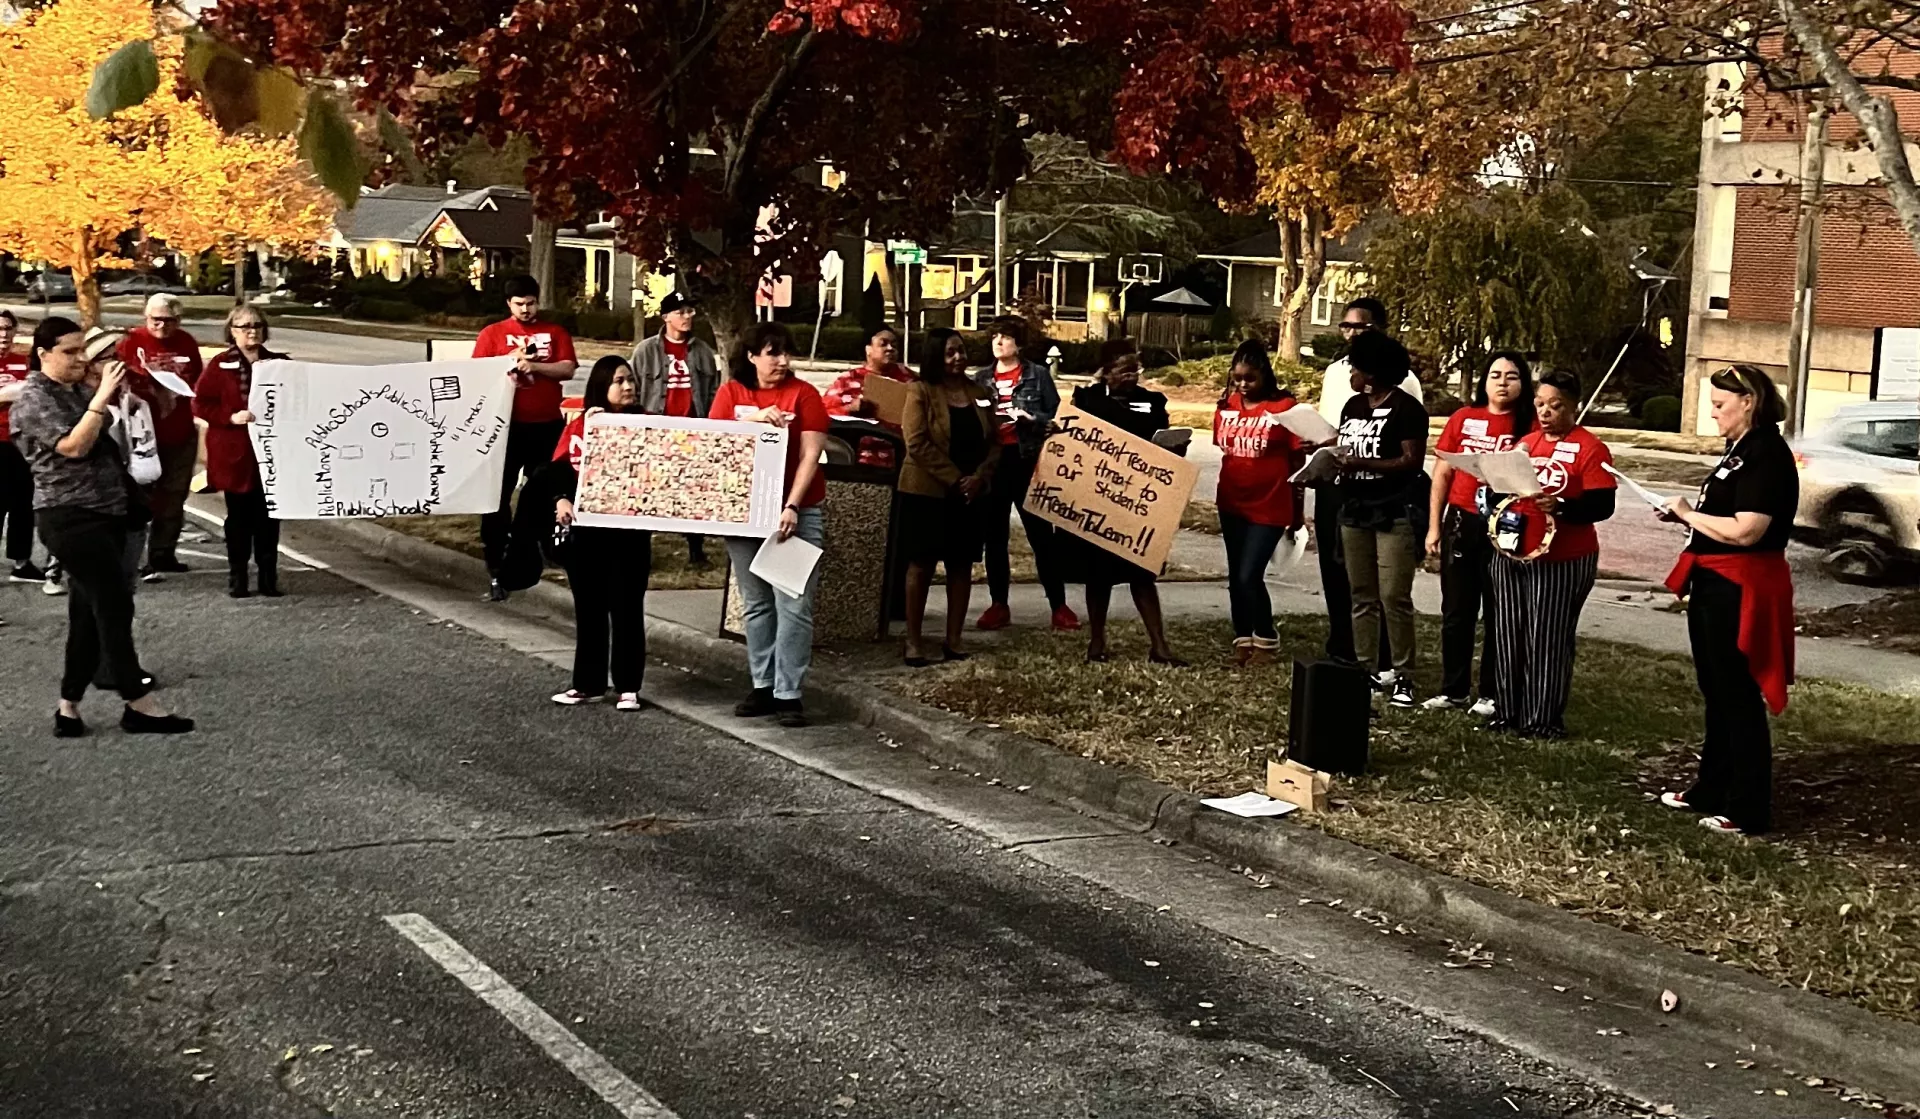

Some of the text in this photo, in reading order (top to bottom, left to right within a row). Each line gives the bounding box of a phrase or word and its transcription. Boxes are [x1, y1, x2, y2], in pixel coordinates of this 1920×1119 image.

[470, 424, 486, 437] To
[1047, 441, 1158, 502] are a threat to
[1056, 464, 1083, 482] our
[1029, 481, 1155, 557] #FreedomToLearn!!
